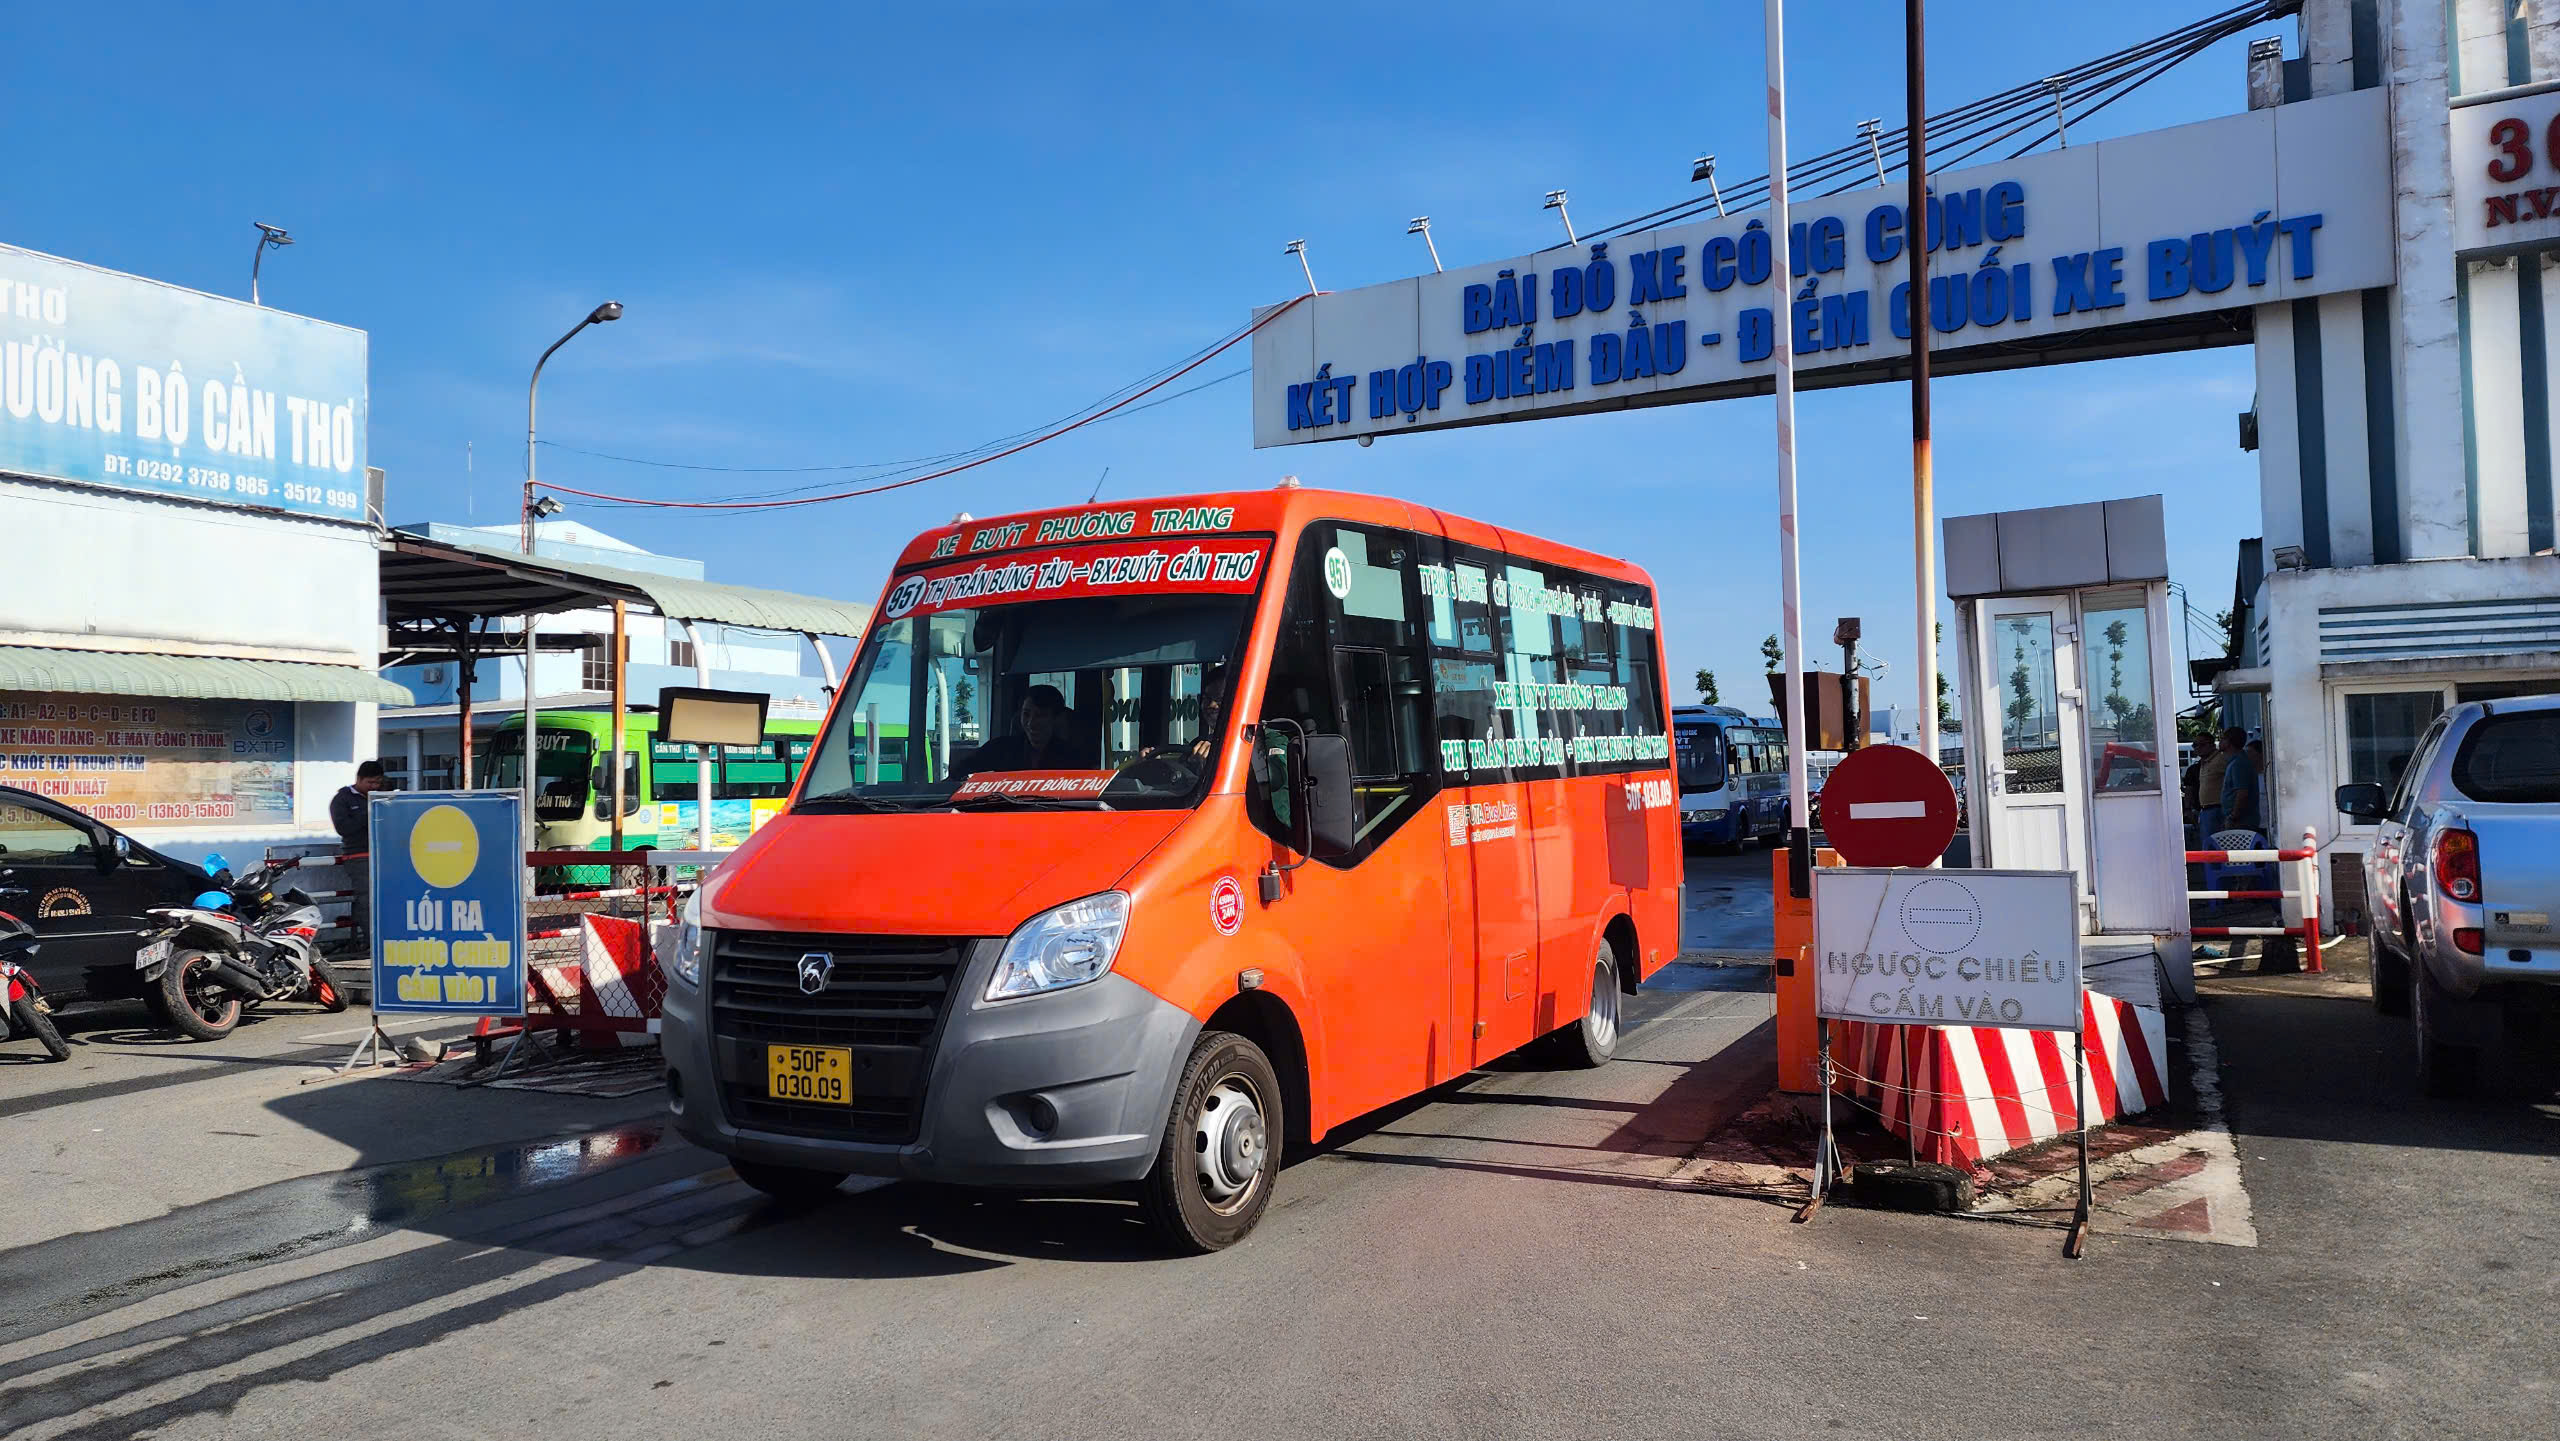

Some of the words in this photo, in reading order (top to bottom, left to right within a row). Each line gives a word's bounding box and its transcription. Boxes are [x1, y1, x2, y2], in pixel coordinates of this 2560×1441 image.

[2488, 113, 2560, 182] 3
[1463, 268, 1537, 335] BÃI
[1551, 242, 1615, 320] ĐỖ
[1629, 245, 1687, 306] XE
[1287, 362, 1356, 431] KẾT
[1369, 355, 1452, 423] HỢP
[1464, 327, 1574, 405] ĐIỂM
[1588, 310, 1686, 387] ĐẦU
[1737, 277, 1870, 364] ĐỂM
[2051, 247, 2125, 317] XE
[2147, 210, 2323, 302] BUÝT
[0, 334, 121, 433] ƯỜNG
[137, 360, 189, 457] BỘ
[203, 361, 275, 460] CẦN
[287, 397, 355, 473] THƠ
[104, 454, 131, 476] ĐT:
[136, 459, 183, 483] 0292
[188, 467, 230, 490] 3738
[235, 476, 268, 496] 985
[283, 482, 322, 504] 3512
[326, 488, 357, 509] 999
[930, 534, 962, 559] XE
[970, 523, 1029, 553] BUÝT
[1035, 511, 1135, 543] PHƯƠNG
[1151, 507, 1235, 533] TRANG
[923, 578, 950, 608] THỊ
[947, 564, 989, 600] TRẤN
[986, 562, 1038, 594] BÚNG
[1035, 557, 1073, 588] TÀU
[1087, 550, 1168, 585] BX.BUÝT
[1167, 546, 1211, 581] CẦN
[1212, 550, 1260, 581] THƠ
[1328, 556, 1348, 590] 951
[888, 581, 924, 612] 951
[1493, 681, 1512, 709] XE
[1512, 676, 1547, 710] BUÝT
[1548, 680, 1593, 710] PHƯƠNG
[1593, 685, 1628, 711] TRANG
[11, 704, 26, 719] A1
[38, 704, 56, 720] A2
[68, 706, 77, 720] B
[90, 705, 98, 721] C
[111, 707, 119, 721] D
[1, 729, 15, 744] XE
[20, 727, 55, 744] NÂNG
[60, 727, 94, 745] HÀNG
[106, 731, 120, 746] XE
[125, 729, 149, 746] MÁY
[154, 730, 186, 747] CÔNG
[233, 740, 286, 753] BXTP
[1441, 739, 1470, 781] THỊ
[1469, 726, 1505, 769] TRẤN
[1506, 730, 1540, 768] BÚNG
[1540, 729, 1564, 765] TÀU
[1573, 725, 1595, 763] BẾN
[11, 752, 45, 769] KHỎE
[49, 755, 70, 774] TẠI
[73, 755, 115, 770] TRUNG
[119, 753, 145, 770] TÂM
[43, 777, 69, 795] CHỦ
[73, 777, 107, 797] NHẬT
[958, 781, 978, 794] XE
[977, 779, 1011, 793] BUÝT
[1009, 780, 1026, 792] ĐI
[1025, 779, 1042, 791] TT
[1040, 776, 1080, 791] BÚNG
[1080, 777, 1108, 791] TÀU
[148, 803, 234, 819] (13h30-15h30)
[1464, 803, 1485, 826] FUTA
[1484, 802, 1498, 823] Bus
[406, 890, 443, 931] LỐI
[452, 900, 484, 931] RA
[1829, 951, 1947, 983] NGƯỢC
[1957, 949, 2065, 984] CHIỀU
[1870, 984, 1944, 1018] CẤM
[1954, 989, 2023, 1022] VÀO
[790, 1049, 826, 1073] 50F
[777, 1074, 842, 1100] 030.09
